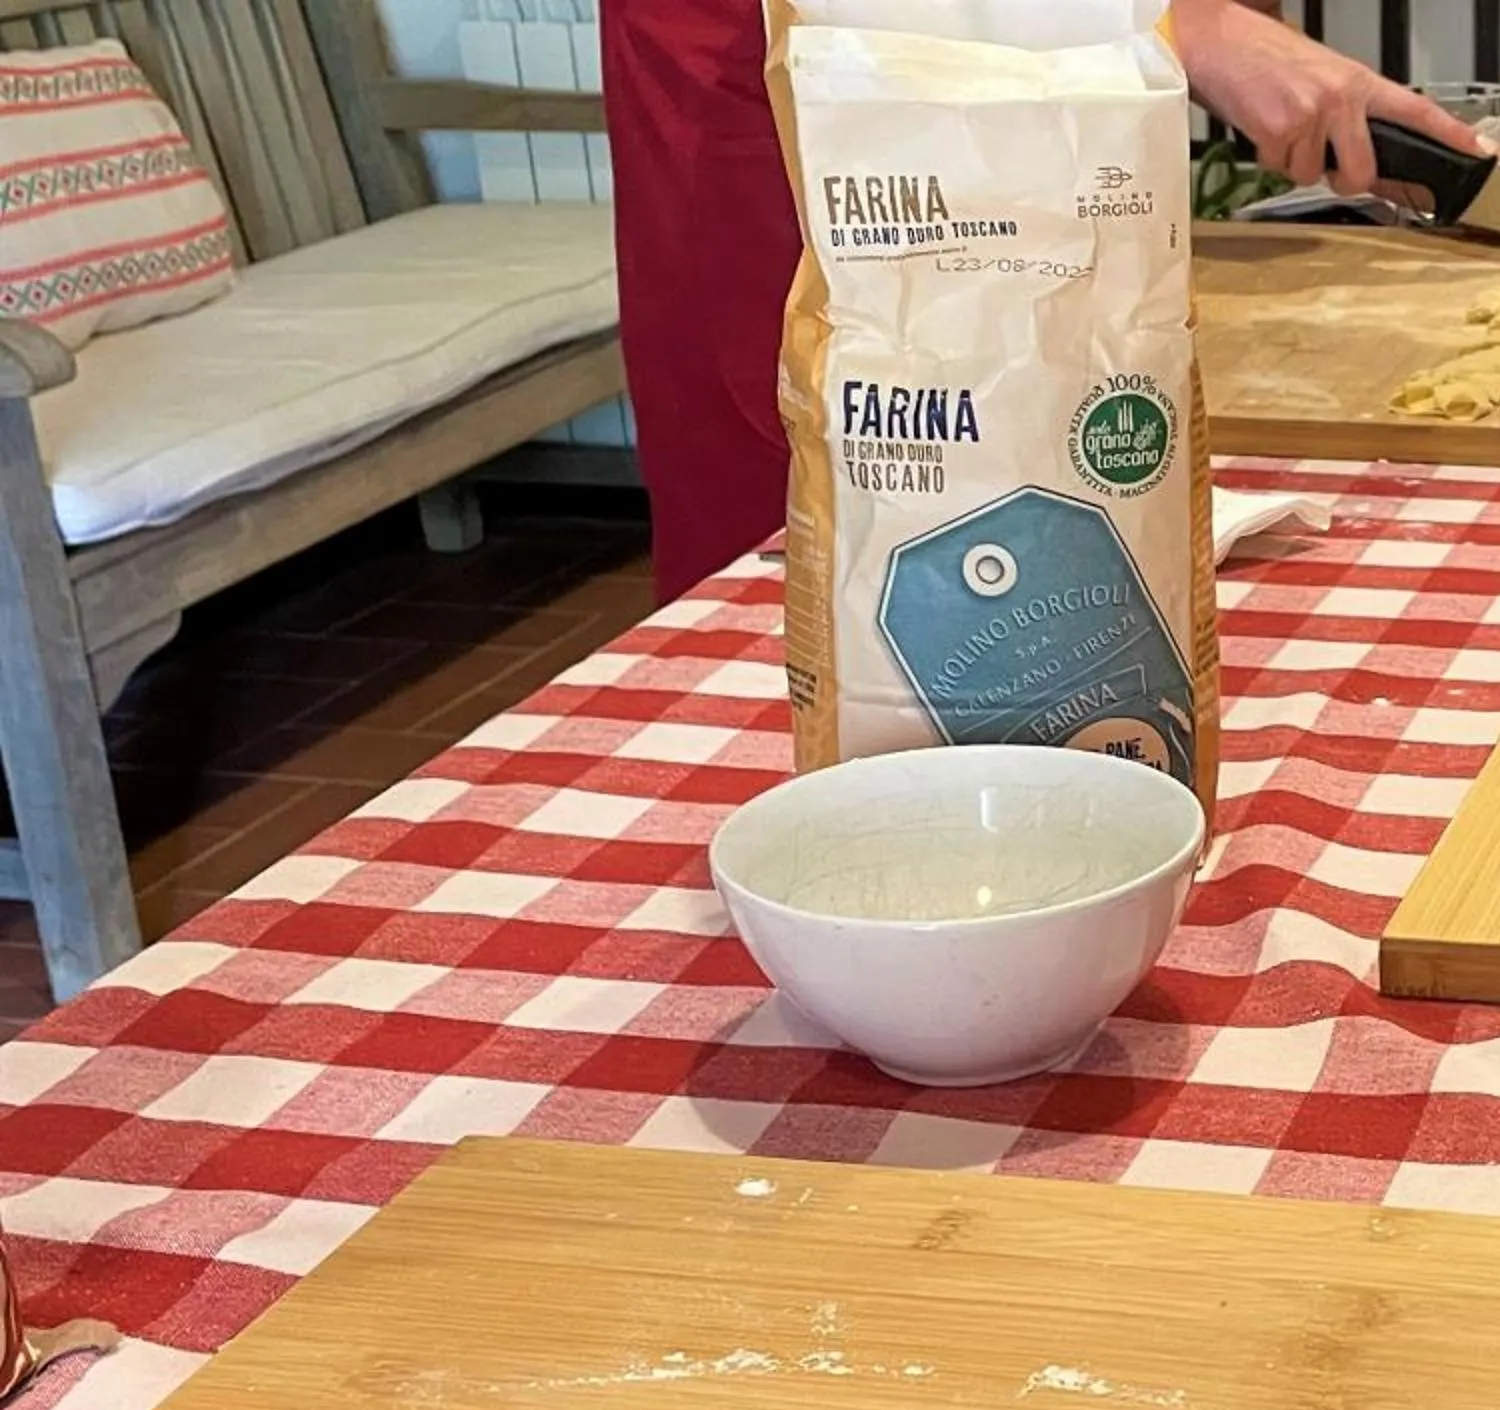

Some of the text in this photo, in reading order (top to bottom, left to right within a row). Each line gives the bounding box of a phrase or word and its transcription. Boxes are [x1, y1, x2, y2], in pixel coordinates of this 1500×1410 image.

[823, 175, 950, 225] FARINA
[1077, 191, 1153, 203] MOLINO
[1077, 201, 1153, 218] BORGIOLI
[831, 221, 1018, 247] DI GRANO DURO TOSCANO
[1106, 373, 1157, 395] 100%
[843, 381, 980, 443] FARINA
[843, 440, 943, 463] DI GRANO DURO
[1085, 433, 1131, 455] grano
[1096, 449, 1159, 470] toscano
[846, 461, 945, 493] TOSCANO
[931, 583, 1130, 699] MOLINO BORGIOLI
[1030, 682, 1119, 741] FARINA
